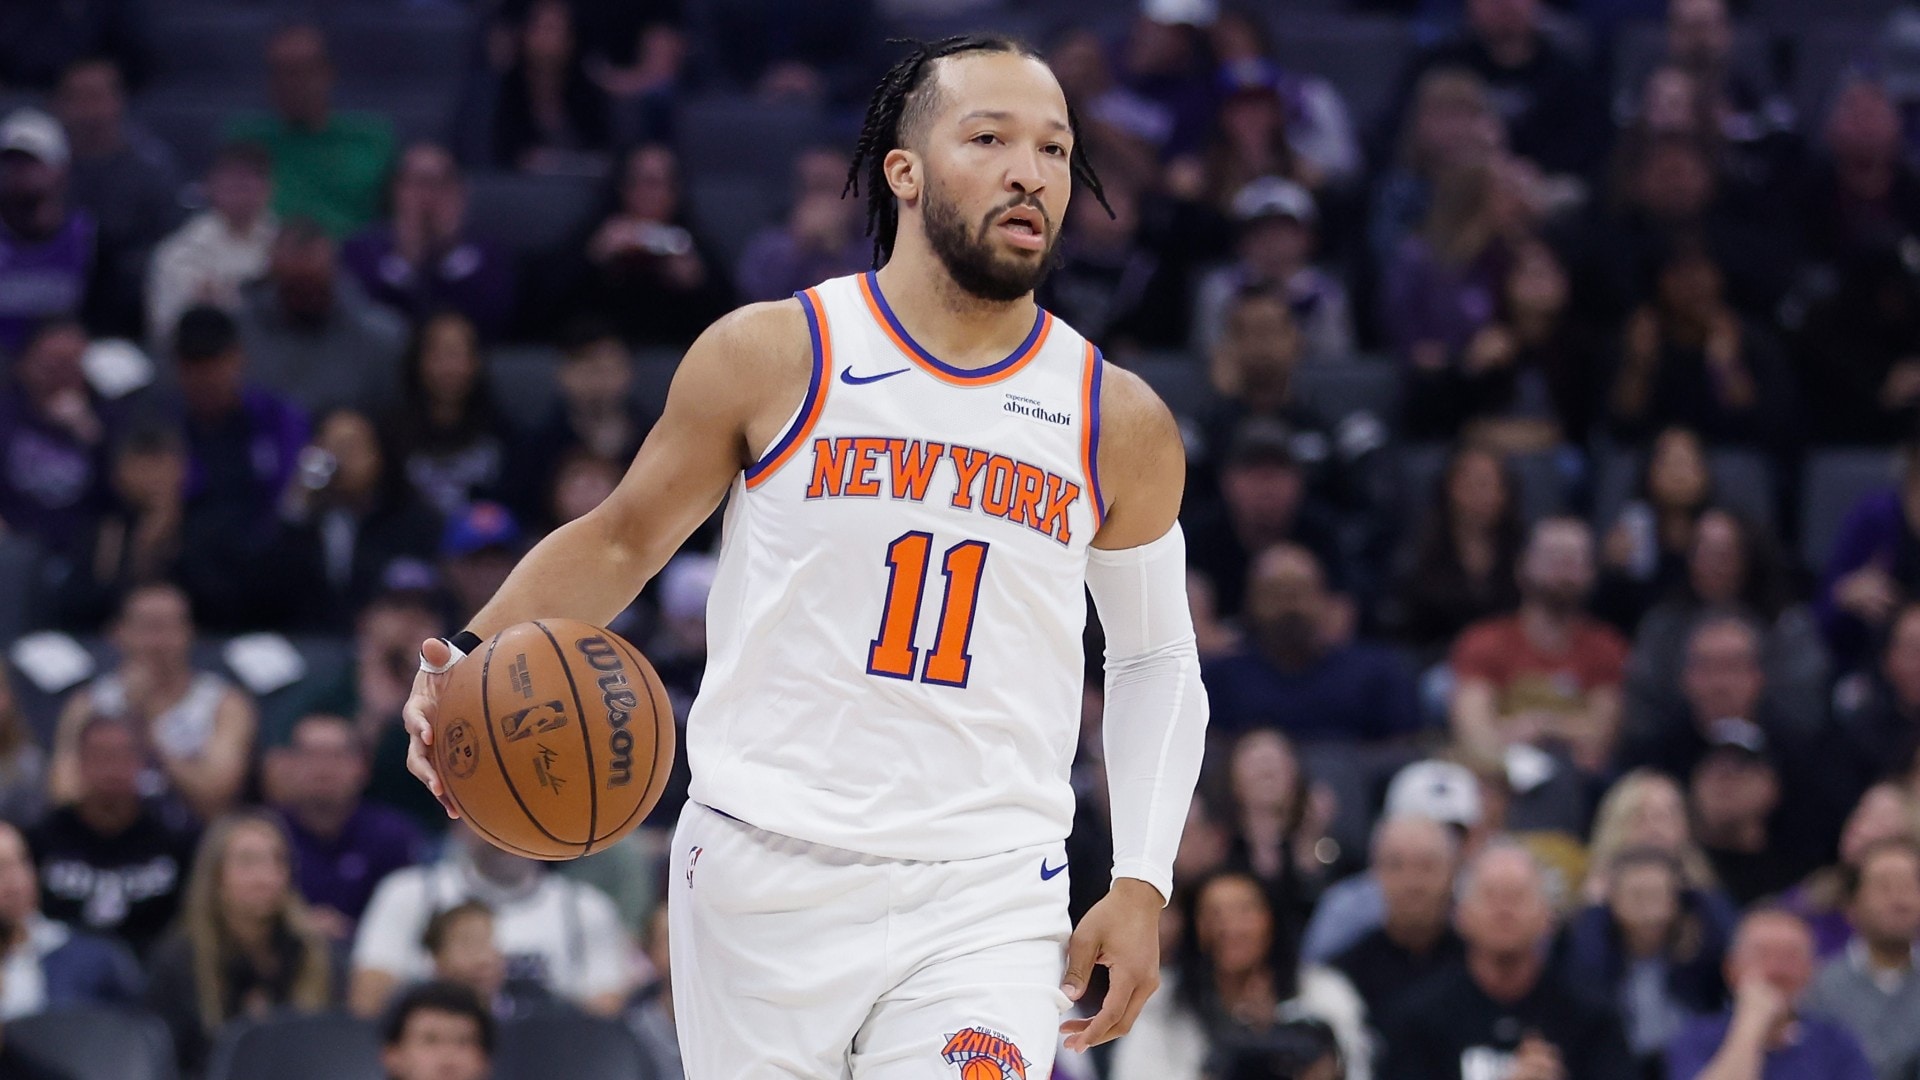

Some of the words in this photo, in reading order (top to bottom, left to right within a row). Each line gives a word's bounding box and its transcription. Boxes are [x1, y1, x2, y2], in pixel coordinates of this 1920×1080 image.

[1003, 401, 1029, 416] abu
[1005, 393, 1041, 406] experience
[804, 437, 945, 502] NEW
[950, 444, 1080, 547] YORK
[866, 530, 990, 689] 11
[575, 635, 637, 790] Wilson
[941, 1027, 1027, 1079] KNICKS
[975, 1026, 992, 1035] NEW
[993, 1029, 1011, 1042] YORK
